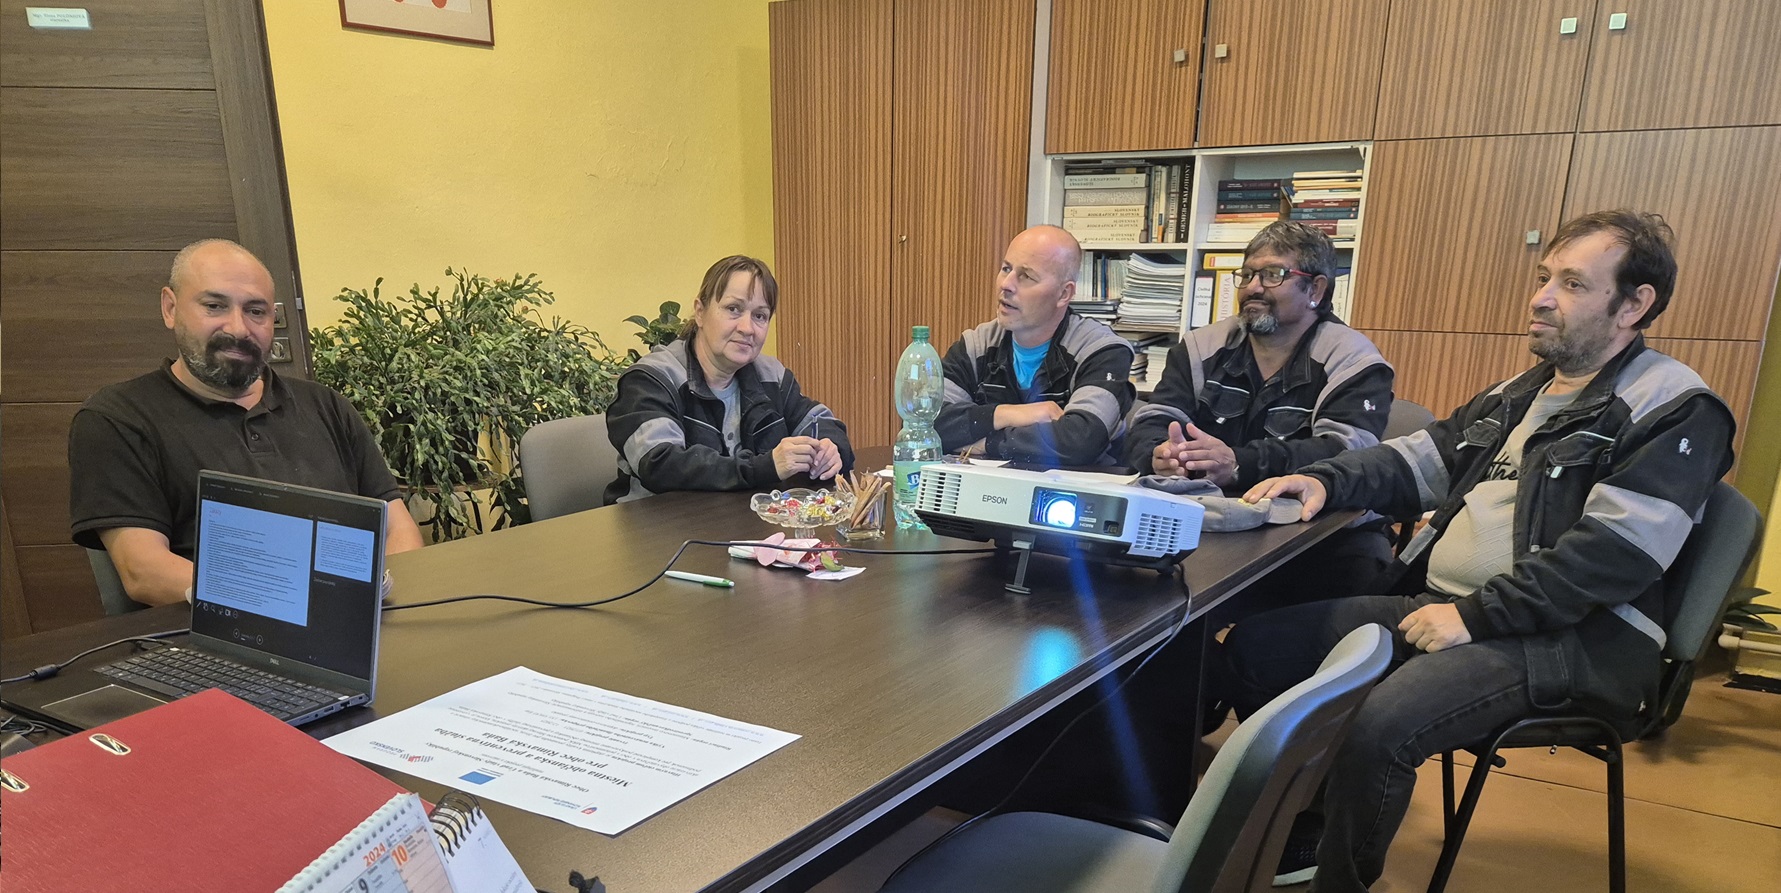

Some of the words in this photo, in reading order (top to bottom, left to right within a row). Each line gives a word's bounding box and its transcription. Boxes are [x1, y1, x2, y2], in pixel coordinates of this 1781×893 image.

[982, 494, 1008, 505] EPSON
[434, 728, 466, 739] služba
[466, 737, 527, 755] preventívna
[507, 740, 559, 757] Rimavská
[534, 756, 586, 772] občianska
[560, 754, 585, 763] obec
[585, 761, 608, 769] pre
[588, 771, 632, 787] Miestna
[363, 842, 387, 867] 2024
[391, 844, 408, 866] 10
[358, 877, 369, 893] 9
